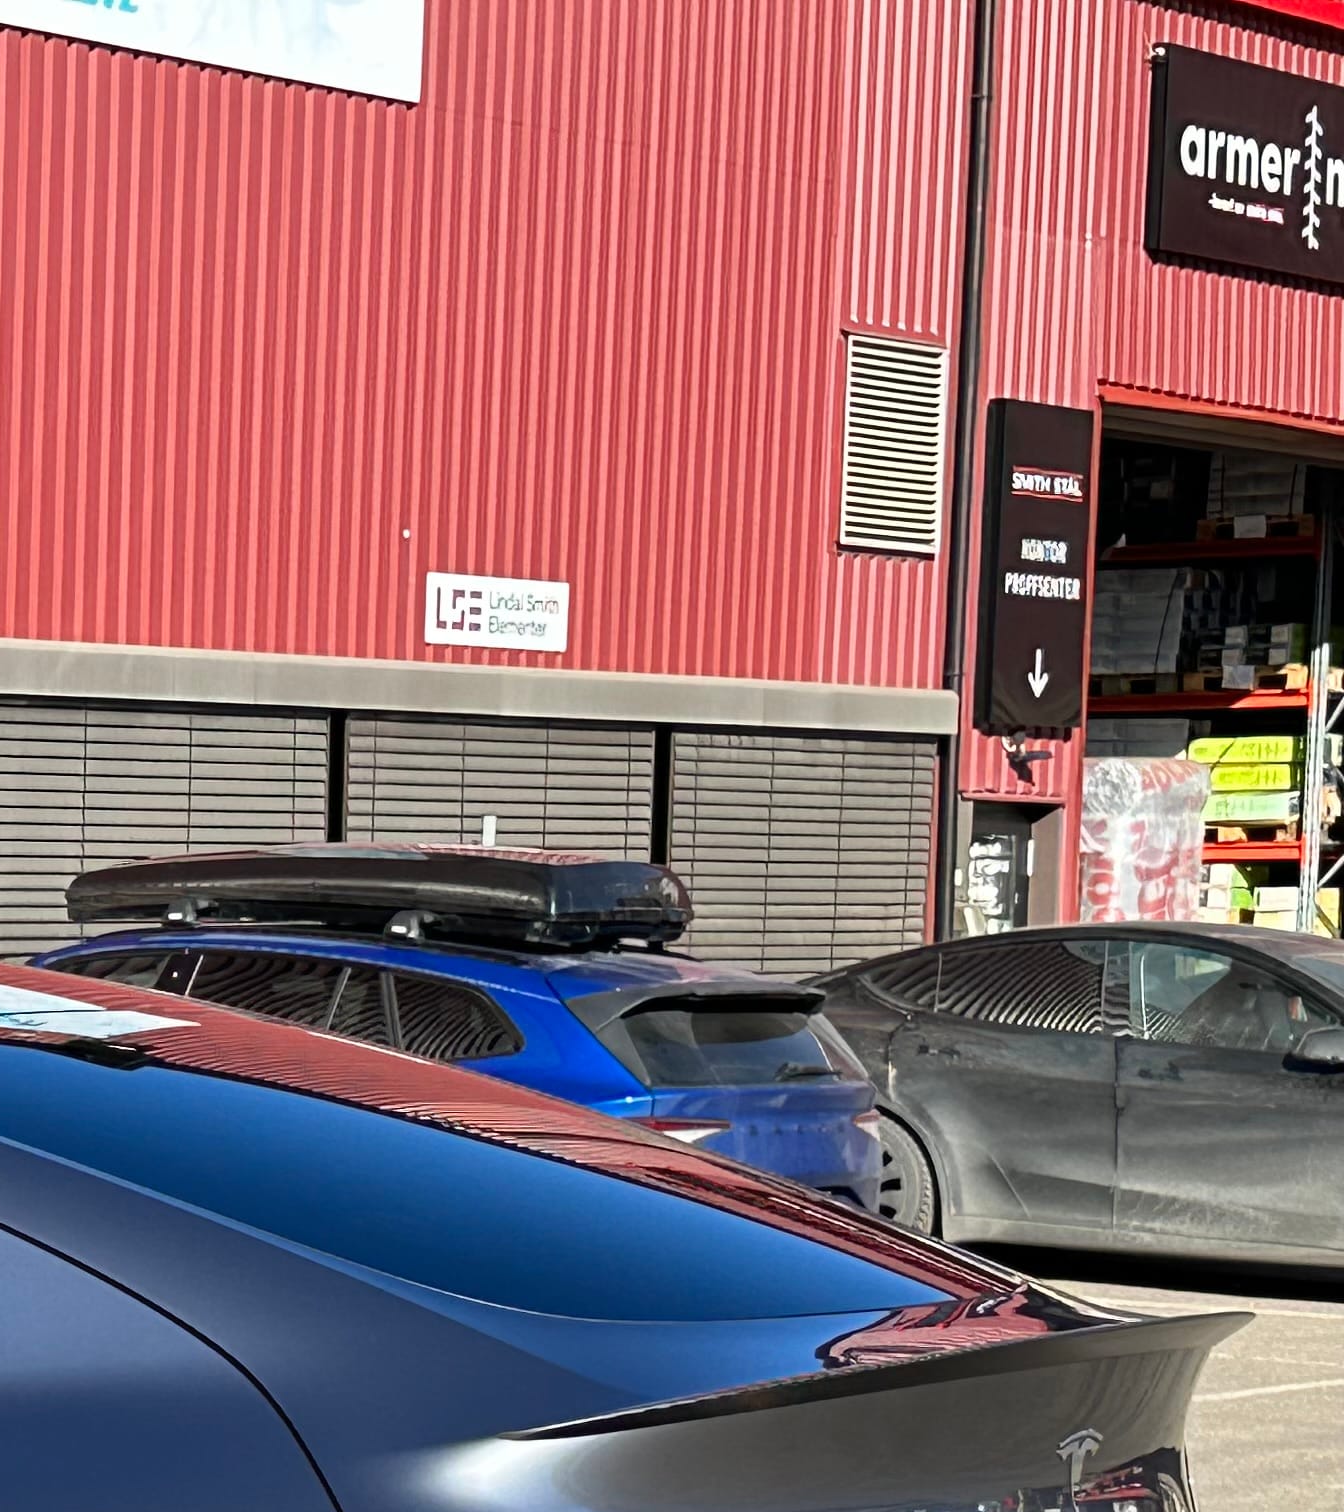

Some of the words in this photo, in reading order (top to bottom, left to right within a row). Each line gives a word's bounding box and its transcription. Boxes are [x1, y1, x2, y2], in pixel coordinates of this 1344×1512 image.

[1180, 125, 1301, 196] armer
[1021, 539, 1067, 564] KONTOR
[1005, 572, 1080, 600] PROFFSENTER
